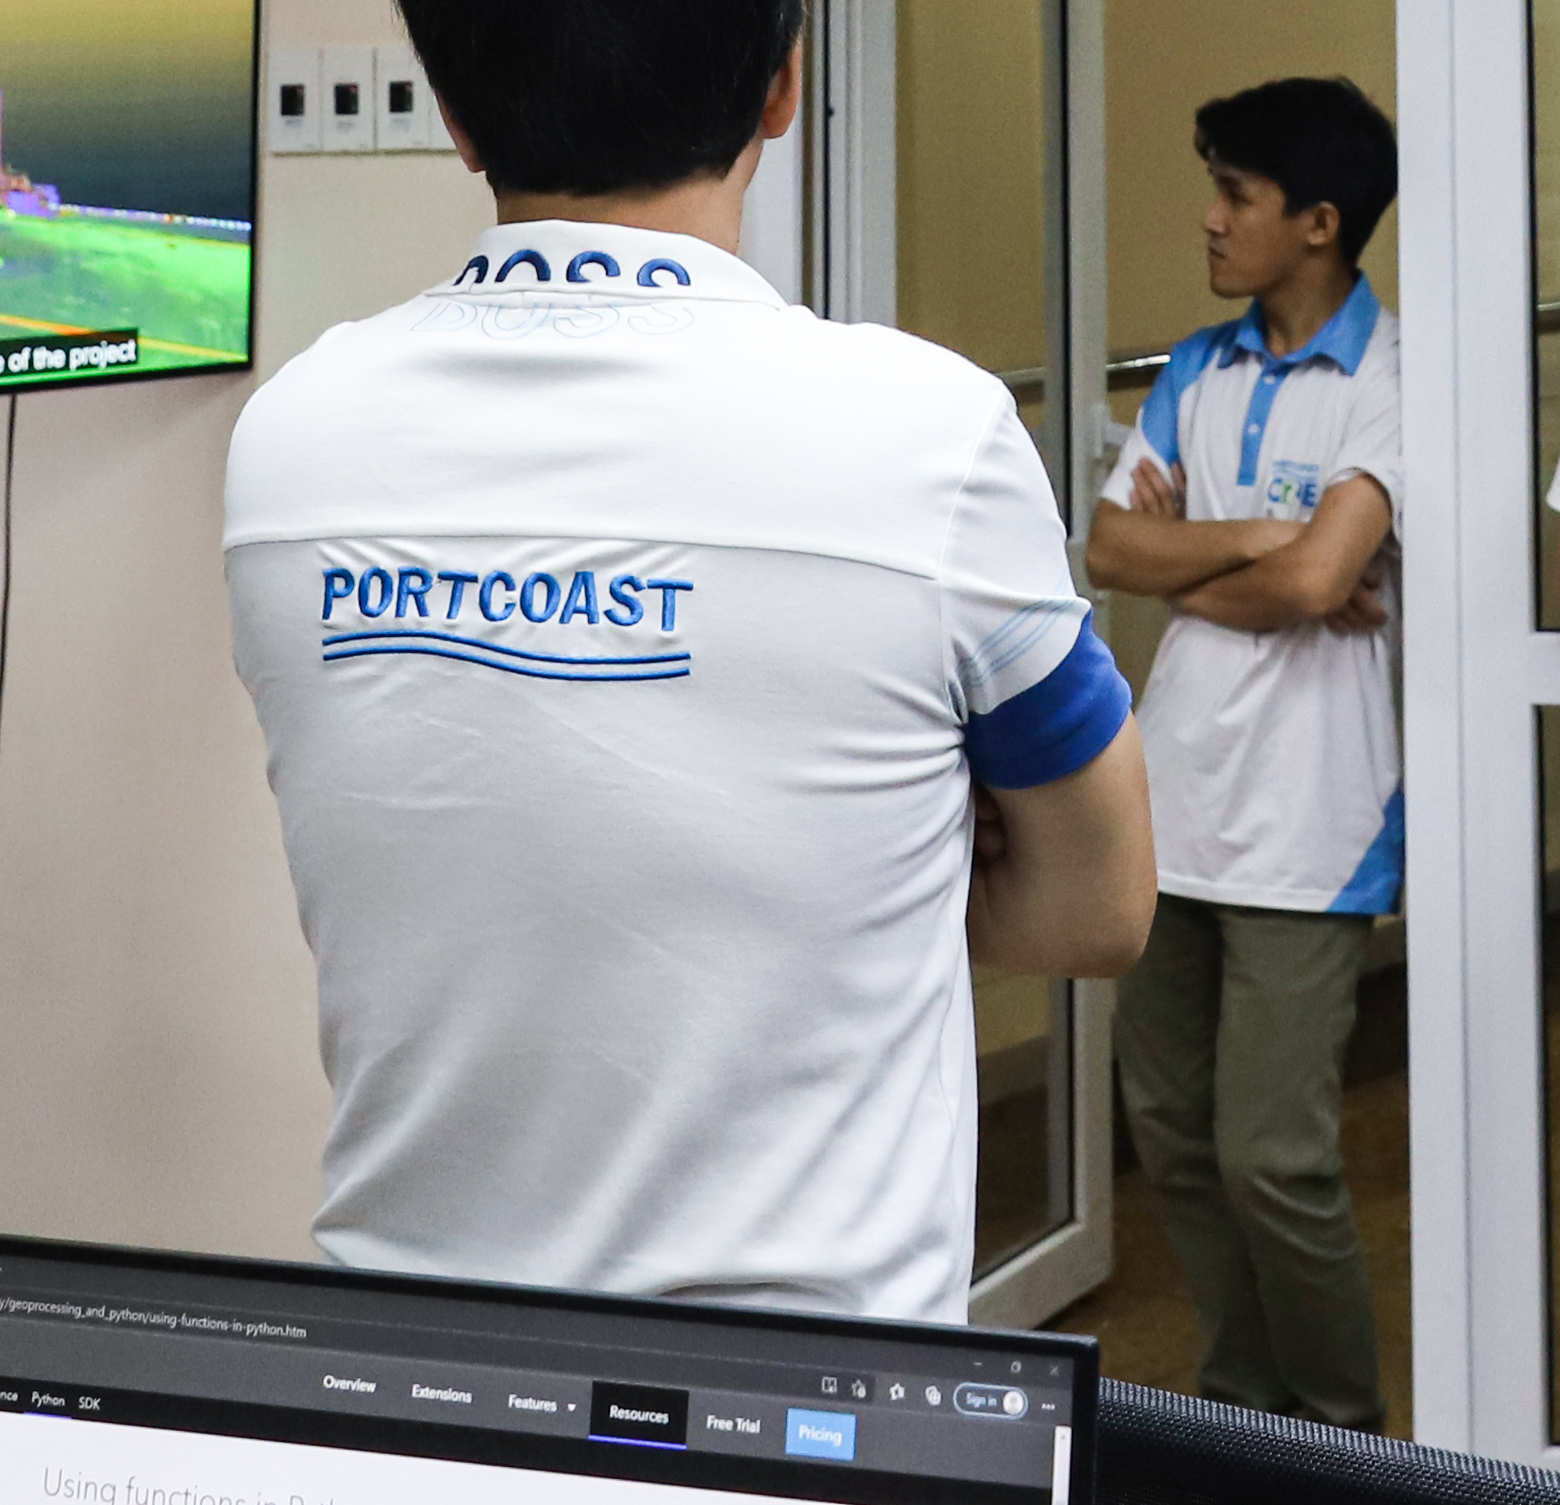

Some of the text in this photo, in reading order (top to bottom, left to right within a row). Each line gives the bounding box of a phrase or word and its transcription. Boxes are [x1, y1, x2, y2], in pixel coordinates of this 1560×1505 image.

[8, 344, 32, 372] of
[33, 342, 66, 369] the
[69, 338, 137, 373] project
[322, 565, 694, 632] PORTCOAST
[31, 1391, 65, 1408] Python
[79, 1396, 101, 1411] SDK
[323, 1374, 843, 1447] Overview Extensions Features Resources Free Trial Pricing
[965, 1392, 997, 1408] Sign in
[43, 1467, 117, 1505] Using
